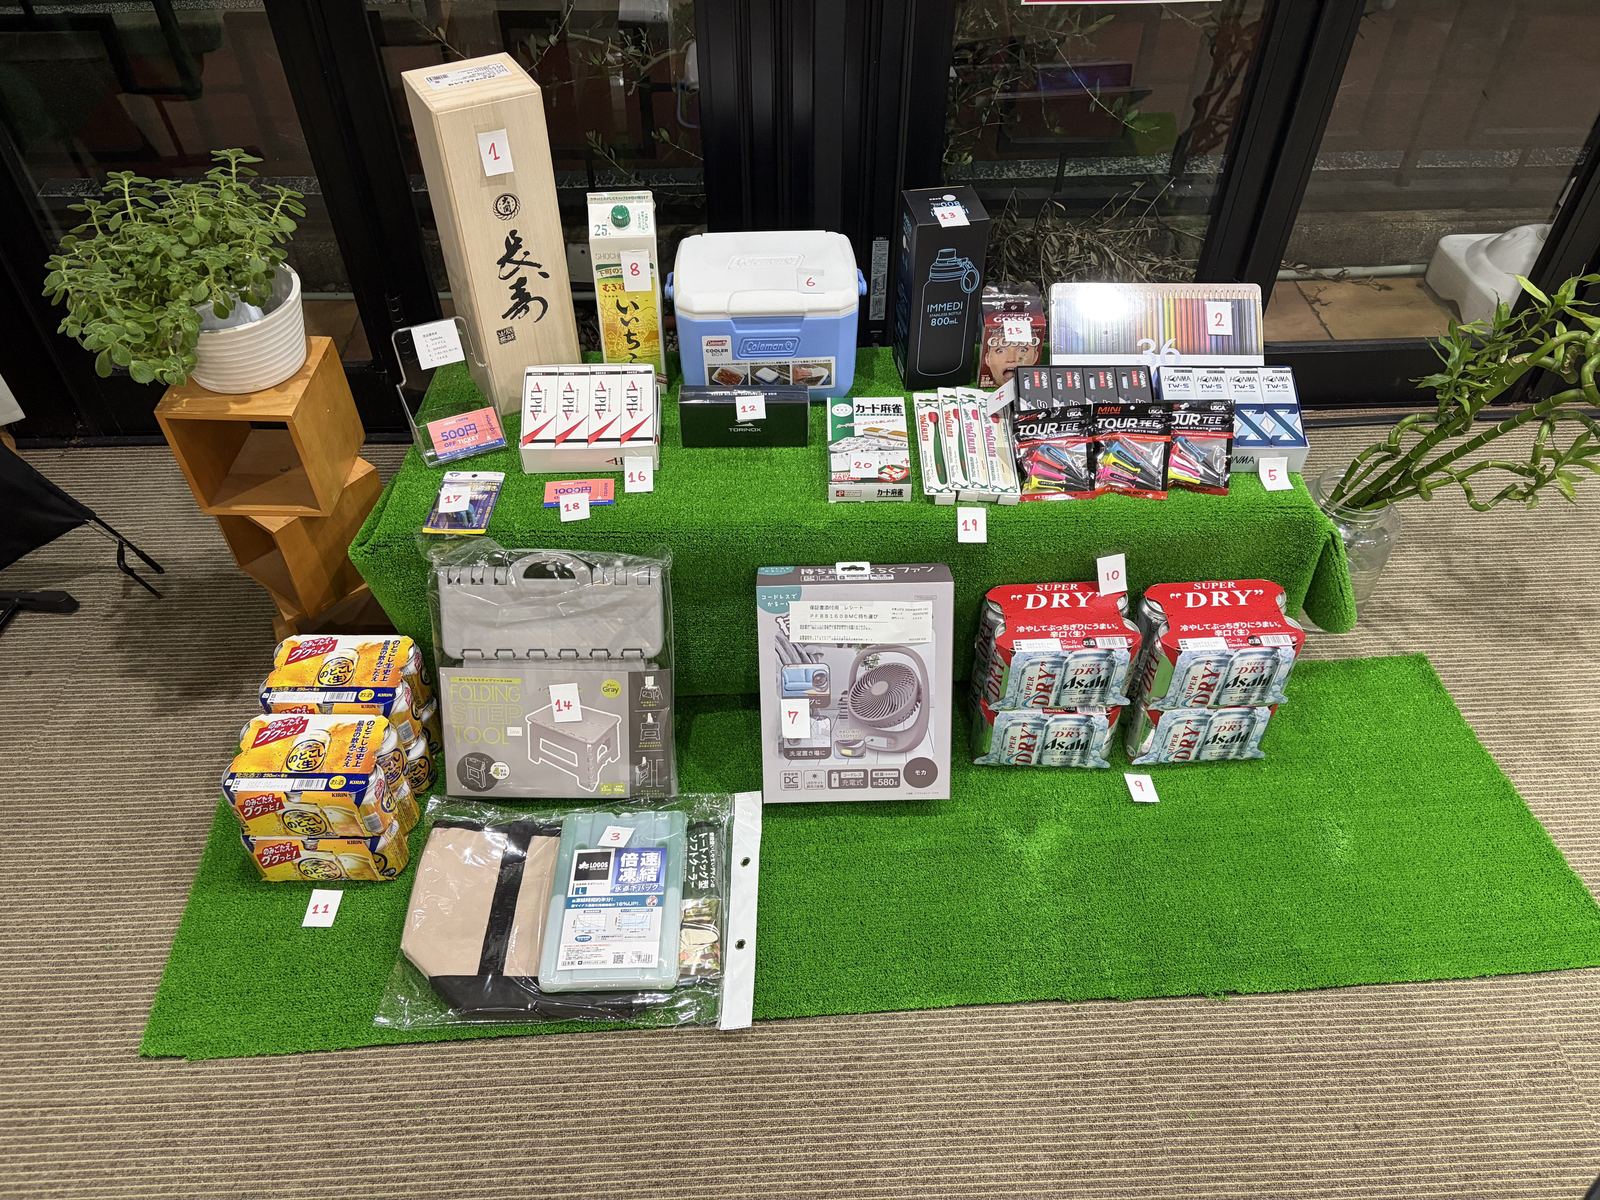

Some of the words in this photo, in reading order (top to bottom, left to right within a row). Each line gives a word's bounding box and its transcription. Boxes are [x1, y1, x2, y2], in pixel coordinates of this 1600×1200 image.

[488, 142, 500, 161] 1
[940, 212, 956, 220] 13
[630, 262, 640, 277] 8
[806, 276, 816, 287] 6
[927, 301, 963, 313] IMMEDI
[1214, 312, 1225, 327] 2
[1007, 327, 1023, 336] 15
[1136, 338, 1181, 365] 36
[740, 404, 757, 413] 12
[855, 403, 904, 414] カード麻雀
[1097, 417, 1138, 429] TOUR
[1203, 416, 1223, 424] TEE
[441, 423, 479, 441] 500円
[1018, 422, 1058, 436] TOUR
[1060, 423, 1080, 431] TEE
[854, 461, 872, 469] 20
[1231, 456, 1255, 464] NMA
[628, 471, 646, 483] 16
[1268, 469, 1277, 481] 5
[554, 485, 592, 494] 1000円
[444, 494, 463, 504] 17
[564, 502, 580, 513] 18
[962, 518, 978, 532] 19
[1106, 570, 1120, 581] 10
[1036, 583, 1079, 592] SUPER
[1194, 581, 1236, 590] SUPER
[1062, 675, 1111, 690] Asahi
[1184, 675, 1199, 699] SUPER
[1225, 674, 1274, 688] Asahi
[450, 684, 521, 701] FOLDING
[602, 686, 620, 694] Gray
[1024, 676, 1036, 699] SUPER
[555, 698, 572, 712] 14
[450, 703, 523, 724] STEP
[788, 710, 799, 725] 7
[452, 725, 511, 745] TOOL
[1204, 731, 1250, 745] Asahi
[1007, 735, 1017, 756] SUPER
[1043, 738, 1090, 751] Asahi
[1167, 733, 1180, 755] SUPER
[784, 776, 799, 784] DC
[1134, 780, 1145, 792] 9
[610, 832, 621, 841] 3
[590, 861, 609, 869] LOGOS
[312, 904, 329, 914] 11
